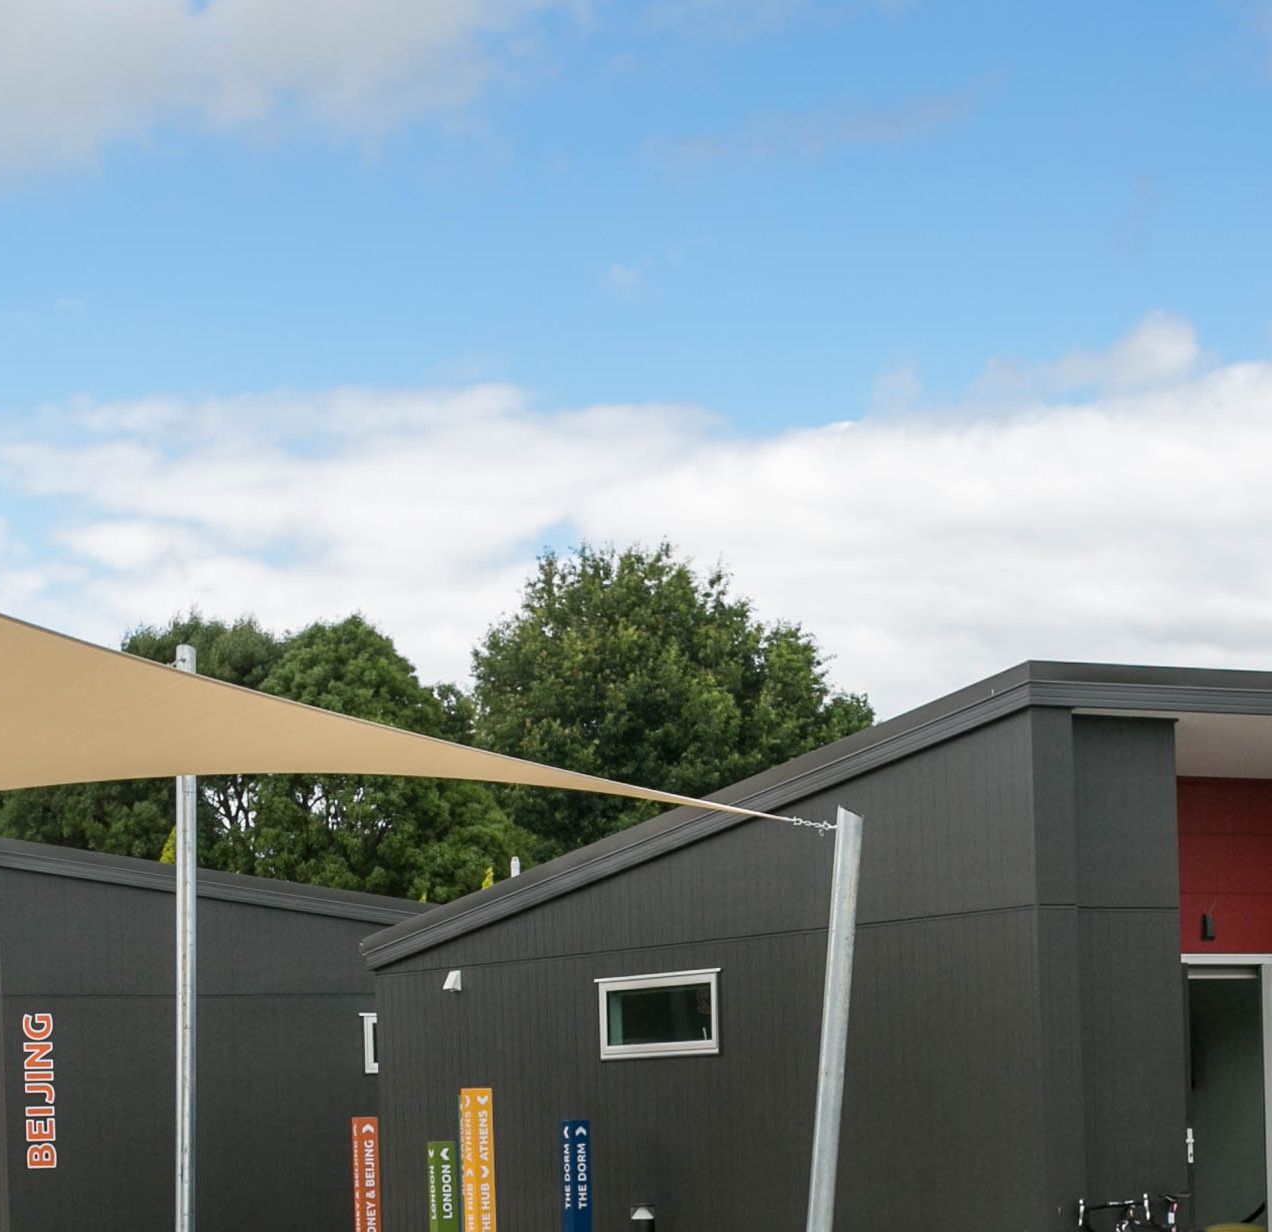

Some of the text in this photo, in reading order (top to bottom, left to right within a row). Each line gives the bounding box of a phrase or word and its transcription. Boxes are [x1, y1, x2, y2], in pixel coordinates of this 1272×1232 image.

[22, 1013, 58, 1169] BEIJING
[478, 1110, 488, 1161] ATHENS
[364, 1139, 376, 1187] BEIJING
[563, 1143, 571, 1182] DORM
[576, 1143, 588, 1210] THE DORM
[365, 1190, 376, 1199] &
[441, 1164, 453, 1219] LONDON
[480, 1183, 490, 1210] HUB
